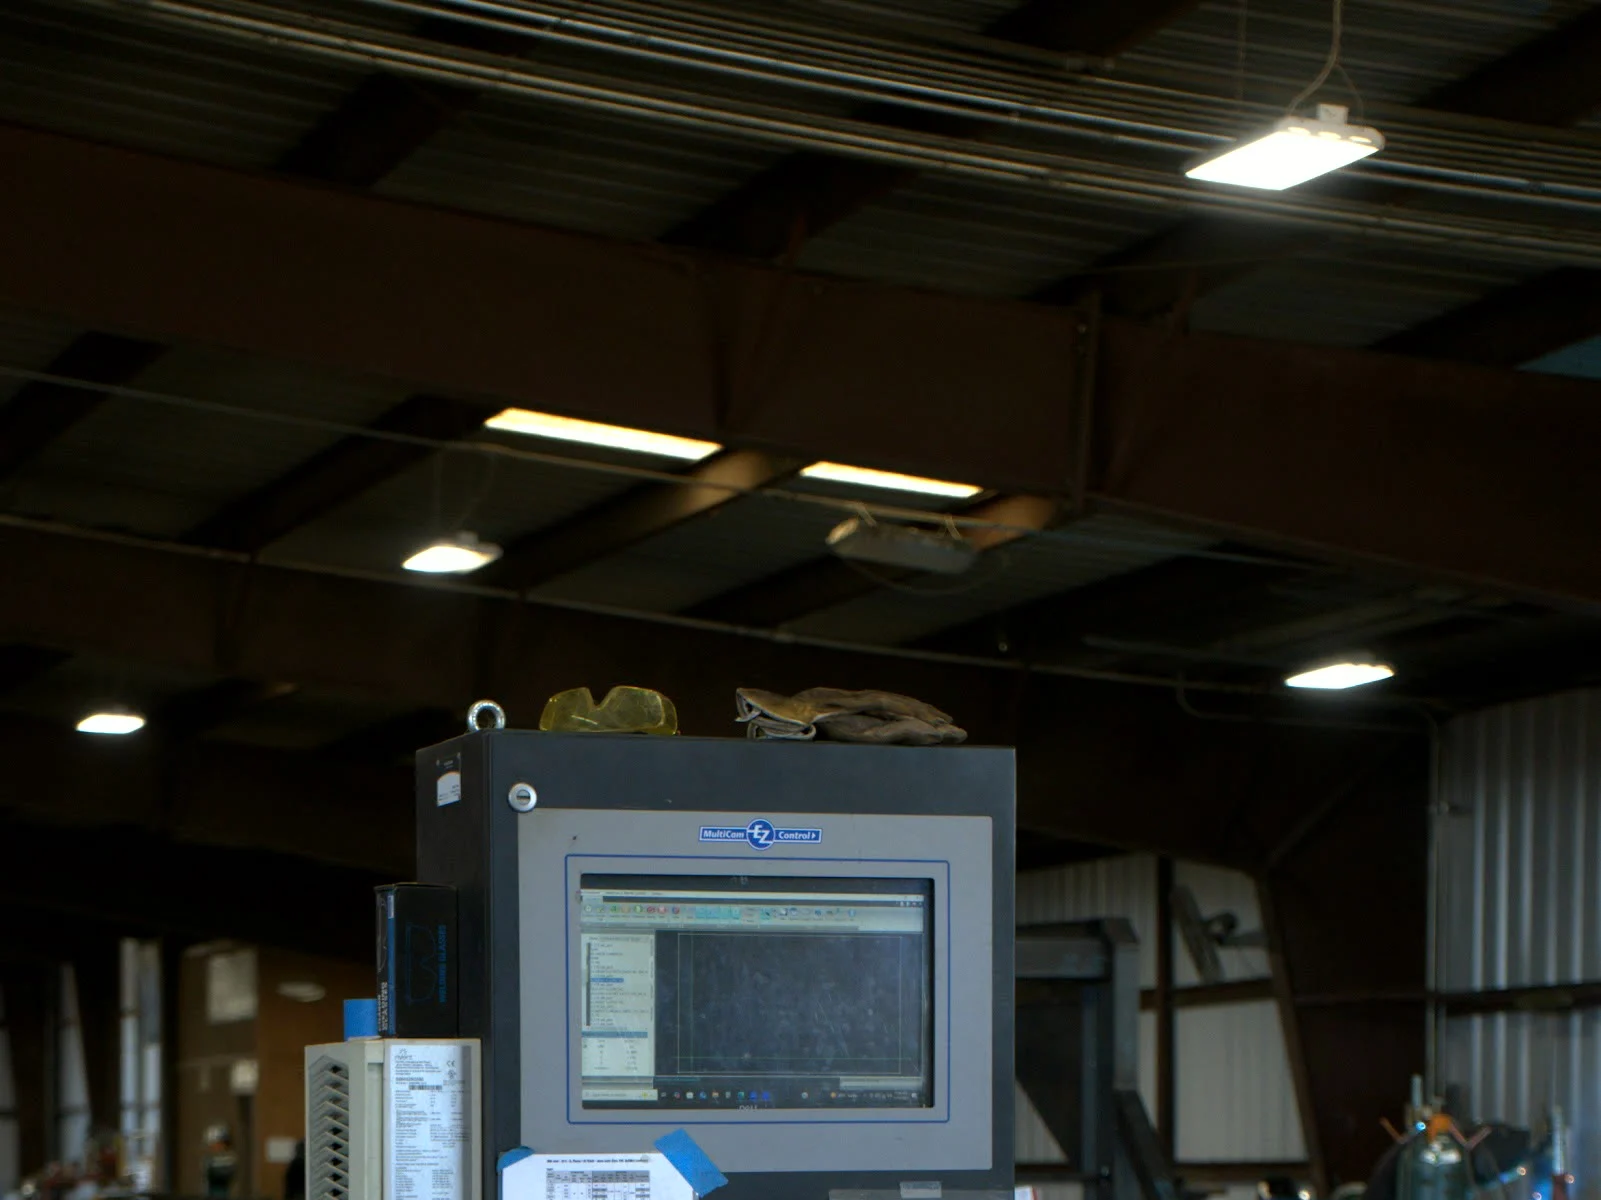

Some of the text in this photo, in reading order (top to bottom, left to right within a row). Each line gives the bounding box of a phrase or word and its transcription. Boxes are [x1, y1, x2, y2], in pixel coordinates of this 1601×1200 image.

[703, 824, 811, 844] MultiCam EZ Control
